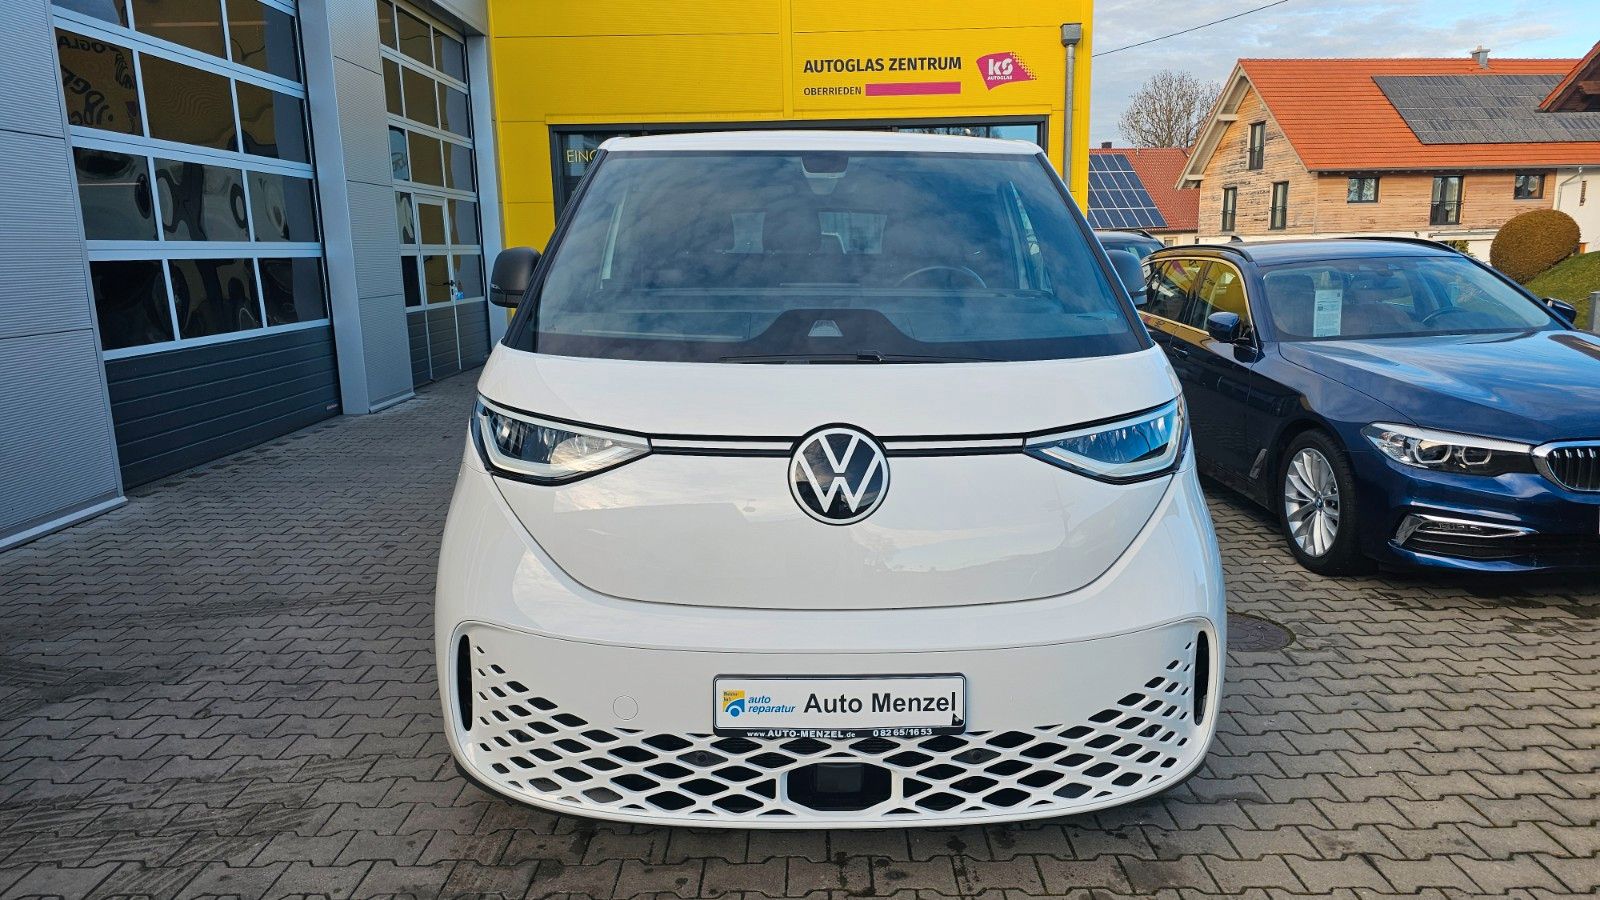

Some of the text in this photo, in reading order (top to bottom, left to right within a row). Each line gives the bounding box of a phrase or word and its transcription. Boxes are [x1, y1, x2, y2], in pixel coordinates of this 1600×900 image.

[803, 56, 962, 73] AUTOGLAS ZENTRUM
[803, 86, 862, 96] OBERRIEDEN
[748, 695, 772, 704] auto
[803, 691, 956, 714] Auto Menzel
[748, 704, 796, 715] reparatur
